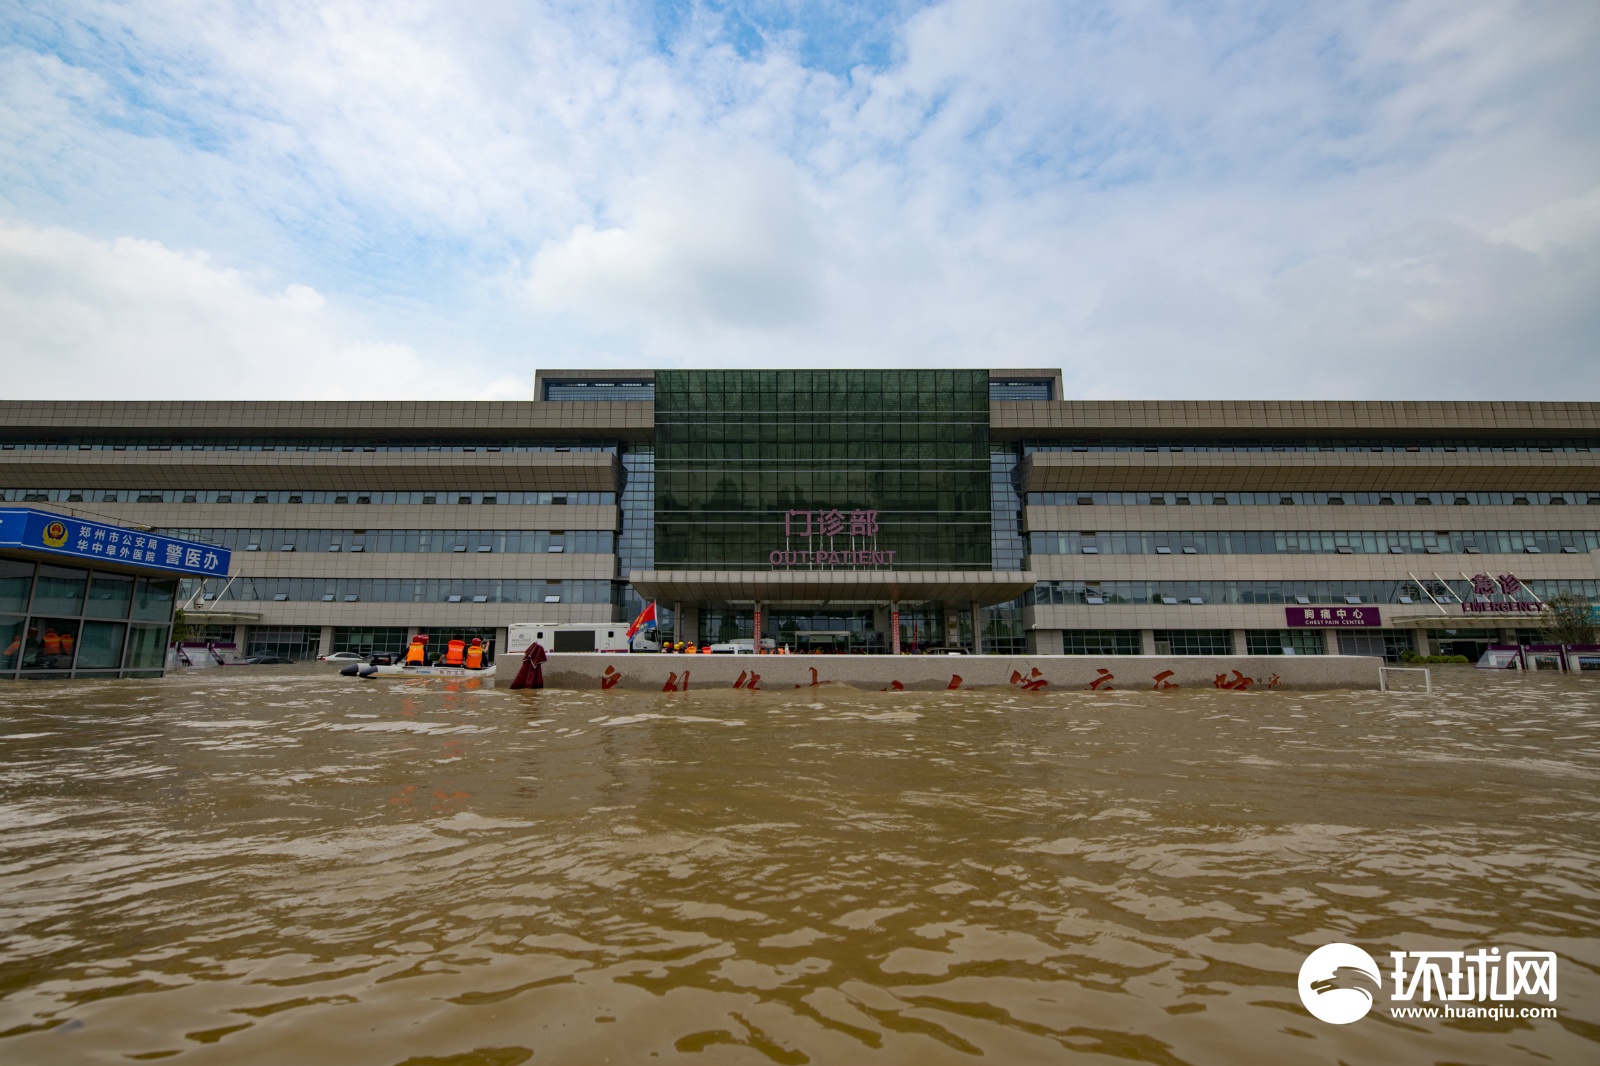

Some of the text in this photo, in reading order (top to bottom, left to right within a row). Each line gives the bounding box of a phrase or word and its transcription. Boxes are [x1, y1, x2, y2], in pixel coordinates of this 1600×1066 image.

[785, 509, 879, 537] 门诊部
[79, 526, 157, 550] 郑州市公安局
[76, 539, 156, 563] 华中阜外医院
[165, 543, 219, 570] 警医办
[769, 550, 896, 566] OUT-PATIENT
[1471, 574, 1521, 595] 急诊
[1304, 608, 1364, 620] 胸痛中心
[1462, 602, 1543, 613] EMERGENCY
